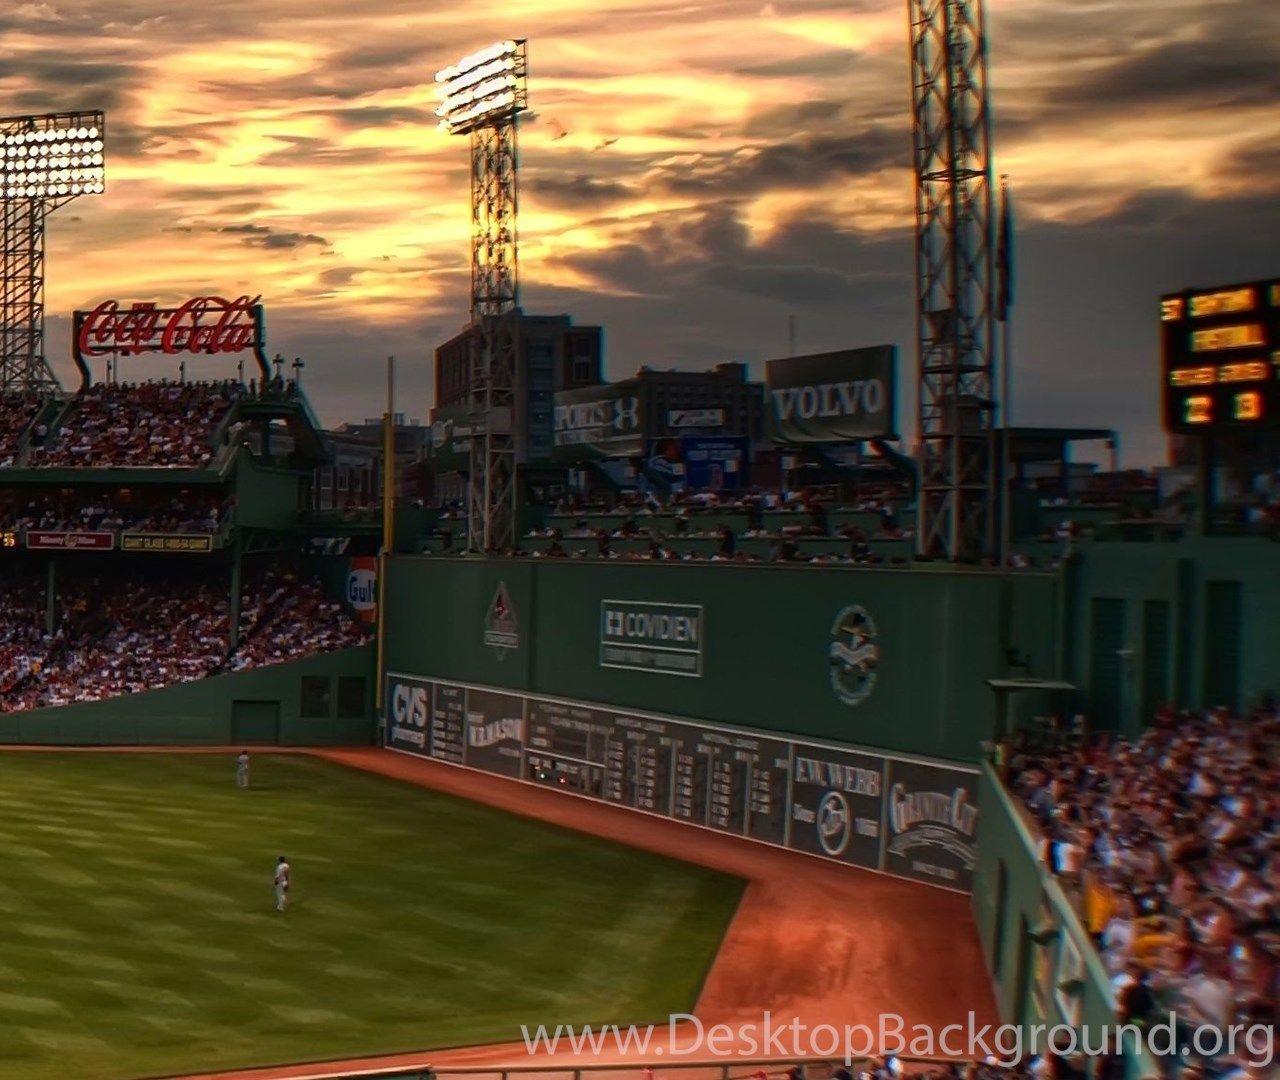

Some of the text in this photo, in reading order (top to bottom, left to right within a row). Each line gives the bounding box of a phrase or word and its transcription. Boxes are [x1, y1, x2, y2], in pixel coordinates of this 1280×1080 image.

[771, 378, 886, 421] VOLVO
[626, 612, 698, 641] COVIDIEN
[392, 683, 428, 728] CVS
